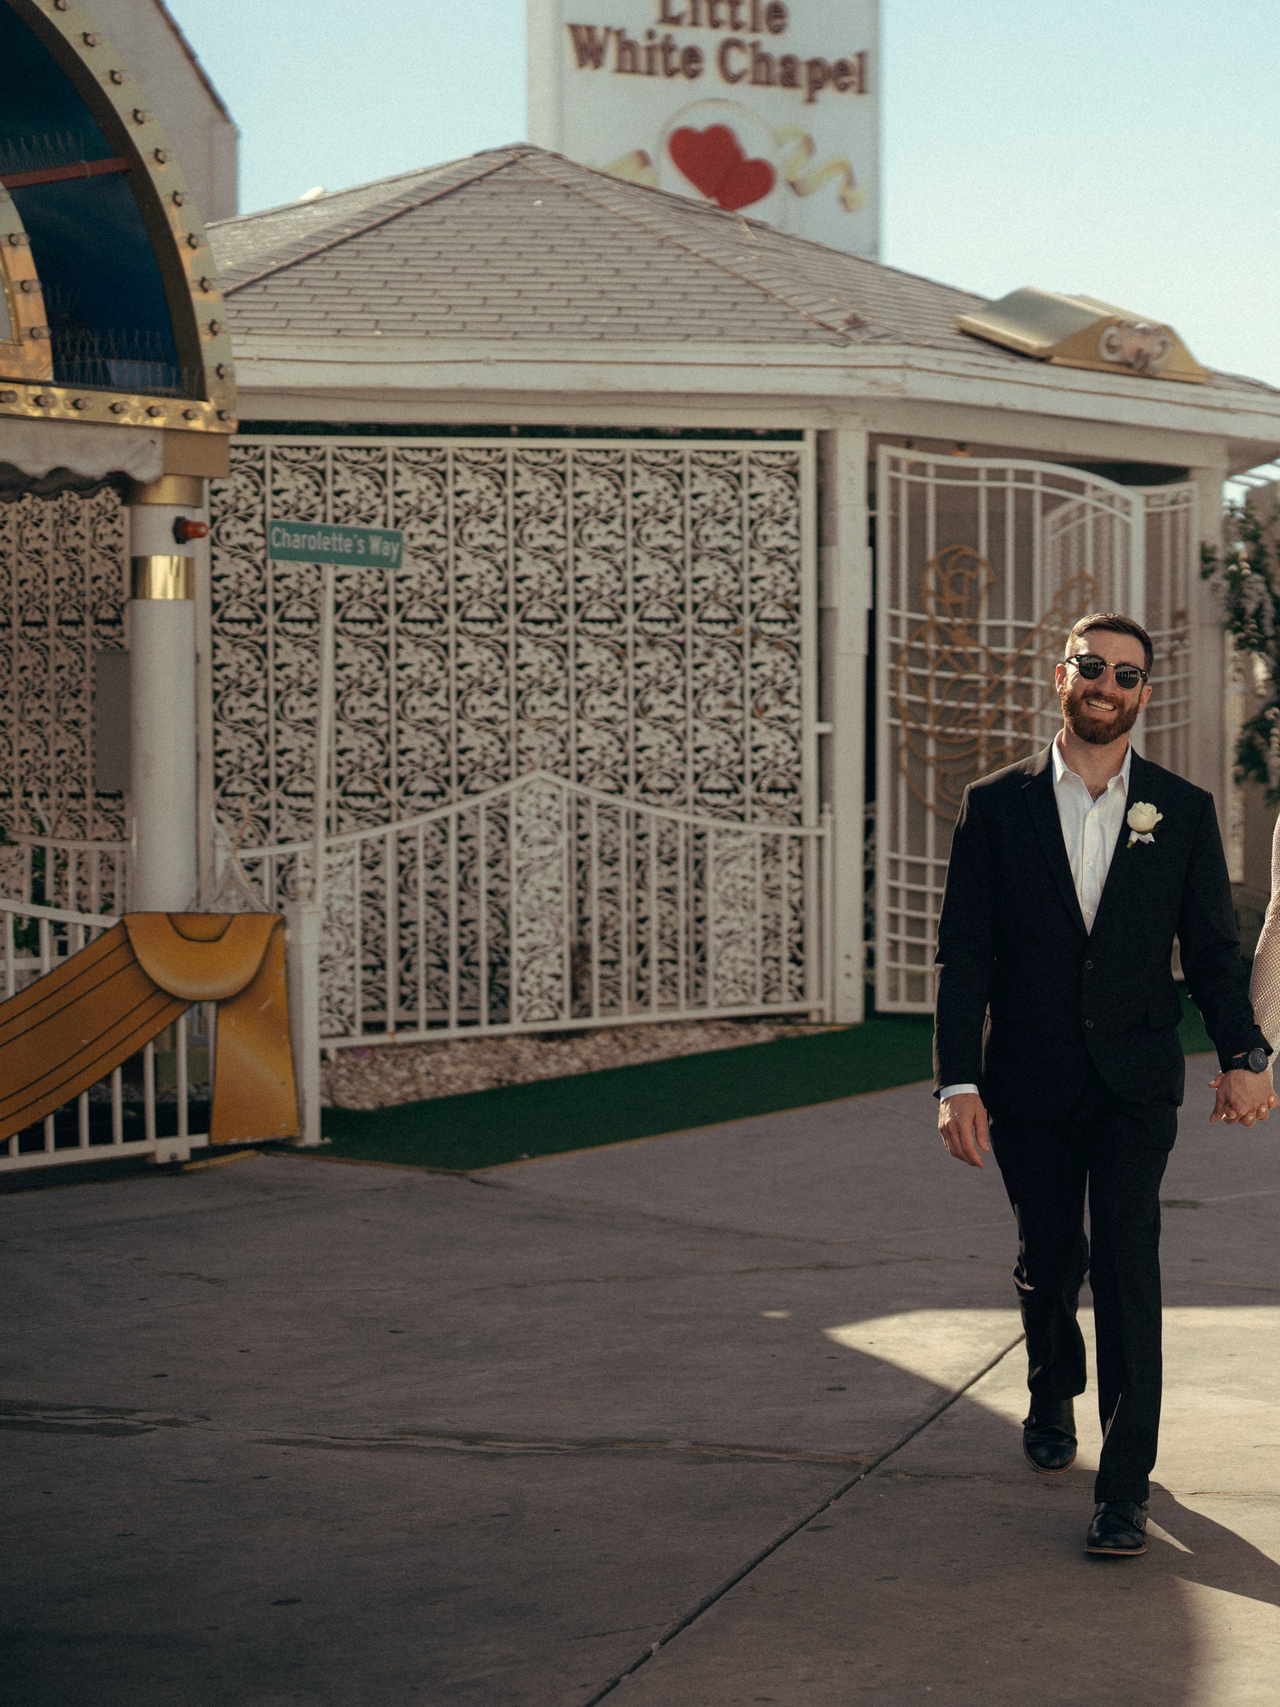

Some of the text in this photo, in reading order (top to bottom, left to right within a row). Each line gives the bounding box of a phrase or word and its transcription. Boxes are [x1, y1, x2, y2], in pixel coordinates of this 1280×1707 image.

[657, 0, 789, 35] Little
[566, 23, 869, 103] White Chapel
[271, 526, 400, 563] Charolette's Way
